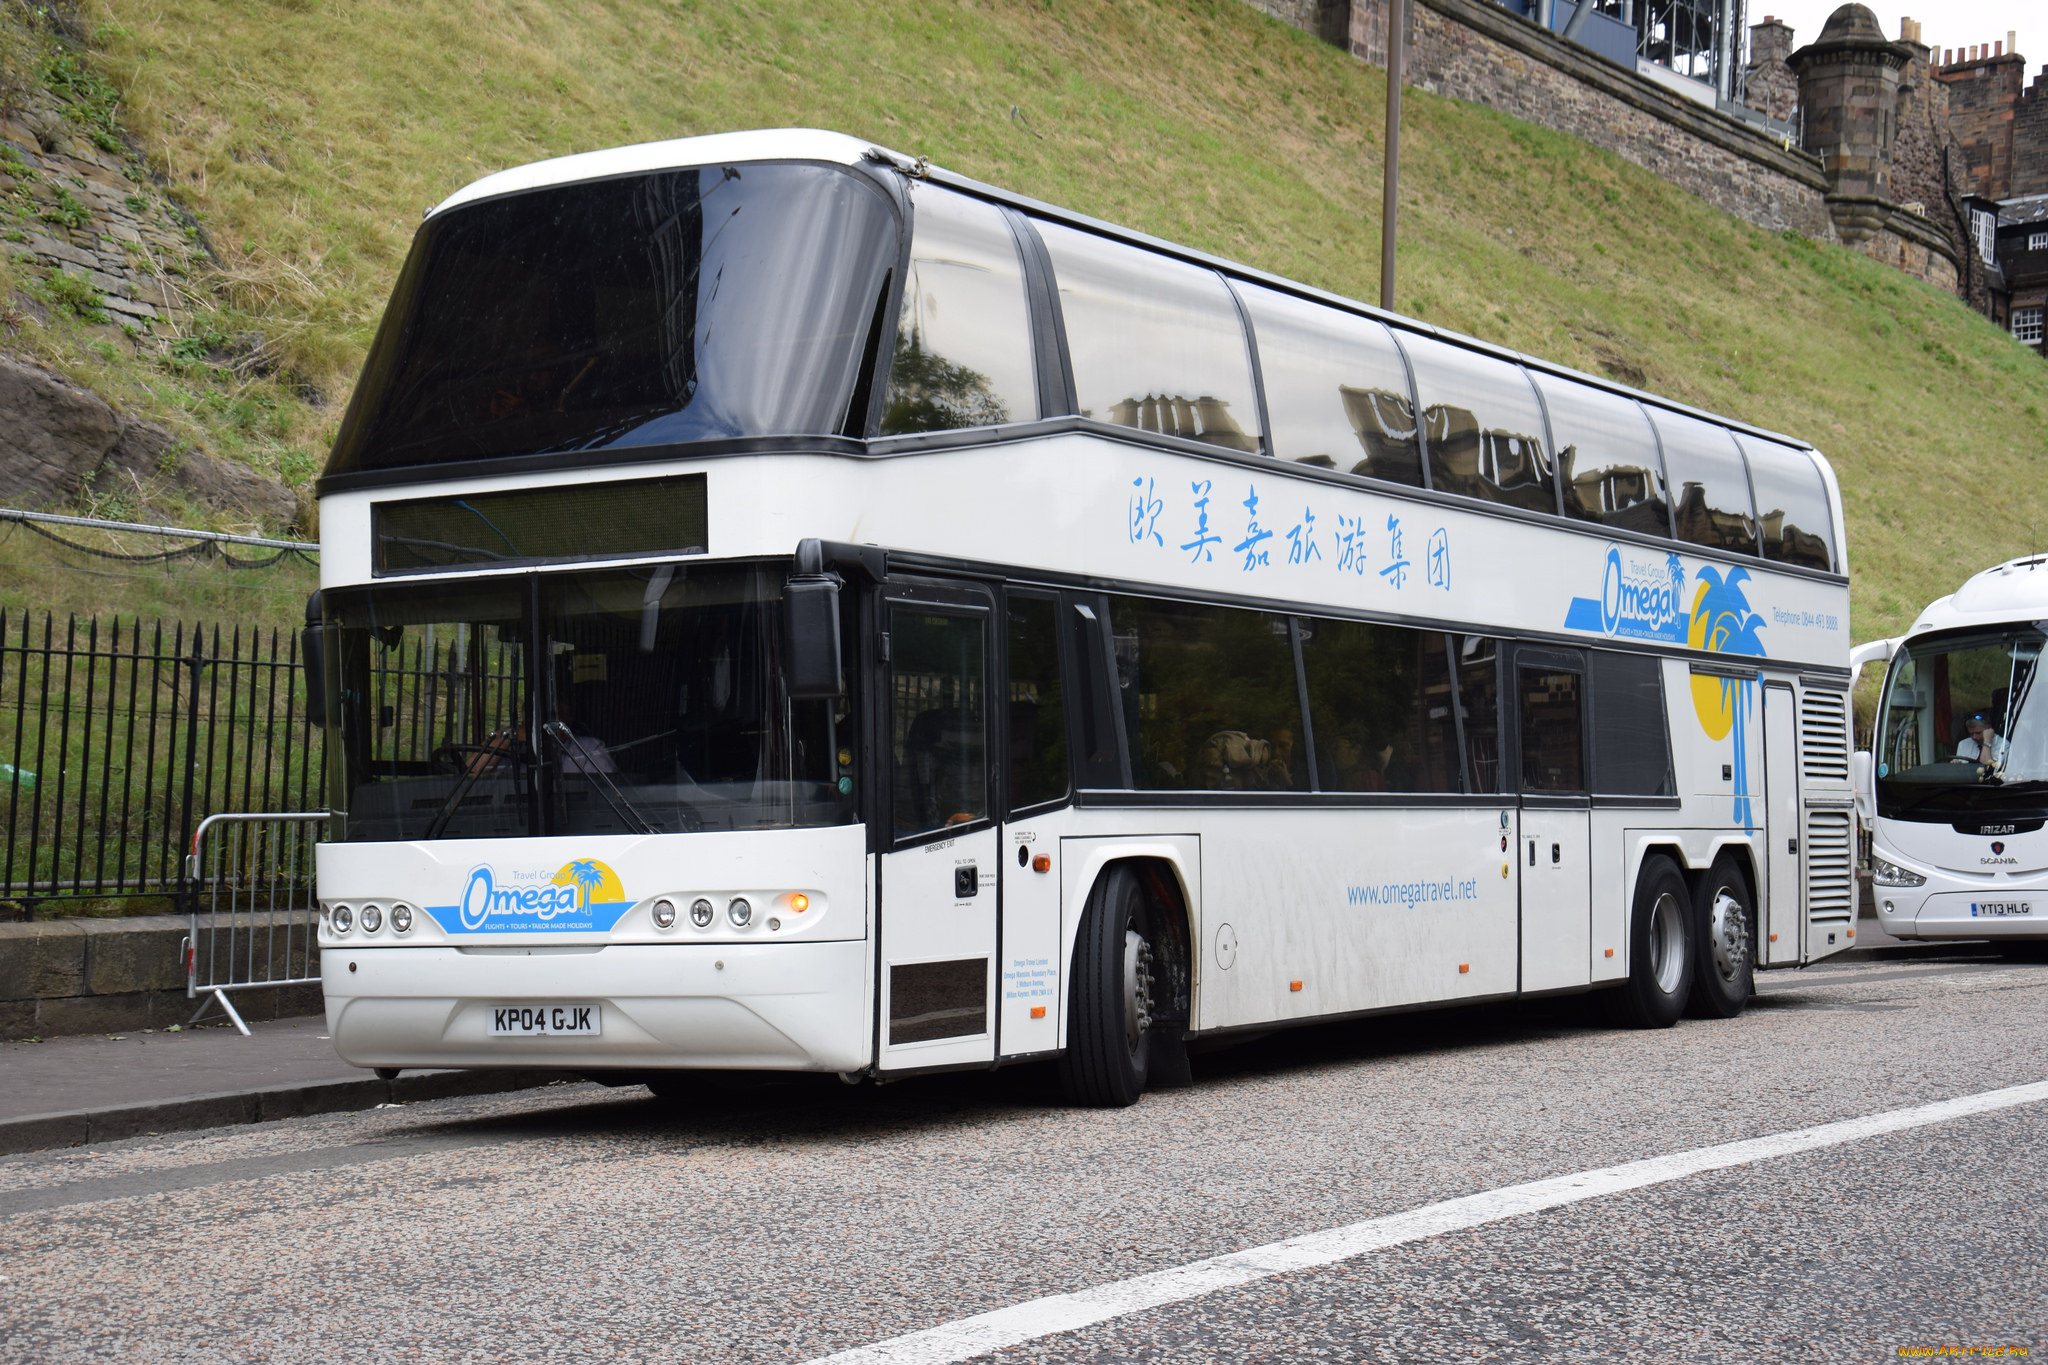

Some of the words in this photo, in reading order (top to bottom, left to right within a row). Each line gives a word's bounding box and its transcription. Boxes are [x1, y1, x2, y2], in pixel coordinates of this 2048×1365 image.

[1129, 477, 1451, 591] 欧美嘉旅游集团
[1629, 559, 1647, 575] Travel
[1648, 563, 1666, 580] Group
[1602, 545, 1672, 635] Omega
[1772, 606, 1801, 627] Telephone
[1980, 824, 2015, 834] IRIZAR
[924, 841, 946, 854] EMERGENCY
[947, 839, 955, 848] EXIT
[1980, 857, 2018, 865] SCANIA
[513, 870, 537, 880] Travel
[539, 870, 567, 881] Group
[462, 866, 576, 928] Omega
[1347, 875, 1478, 910] www.omegatravel.net
[1980, 903, 2004, 914] YT13
[2006, 903, 2030, 914] HLG
[567, 921, 593, 929] HOLIDAYS
[495, 1008, 546, 1031] KP04
[552, 1007, 591, 1031] GJK
